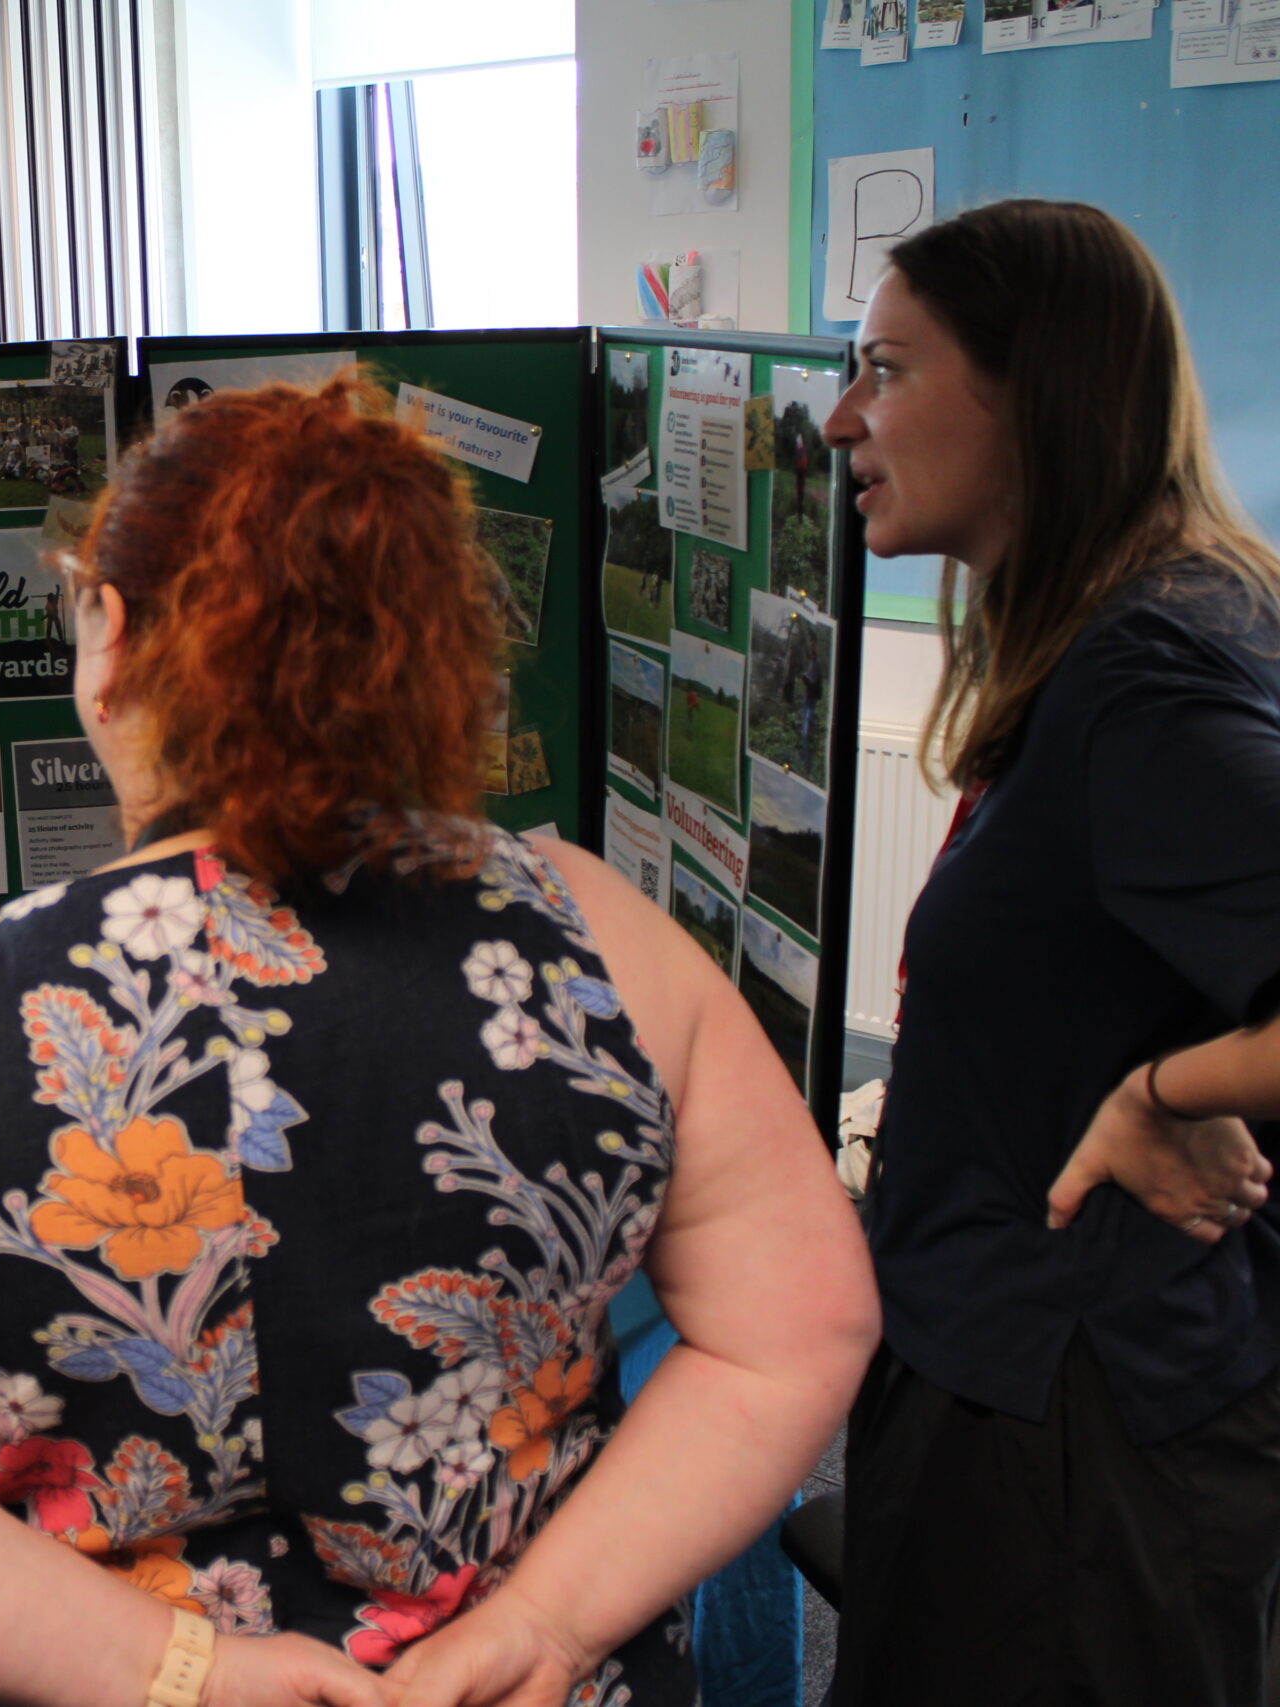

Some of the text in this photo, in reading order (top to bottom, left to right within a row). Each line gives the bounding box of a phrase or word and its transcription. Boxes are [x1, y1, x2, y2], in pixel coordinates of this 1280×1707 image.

[438, 403, 446, 417] is
[448, 410, 473, 425] your
[475, 417, 528, 444] favourite
[458, 440, 502, 462] nature?
[30, 757, 104, 786] Silver
[56, 782, 73, 792] 25
[68, 823, 94, 831] activity
[665, 791, 744, 888] Volunteering
